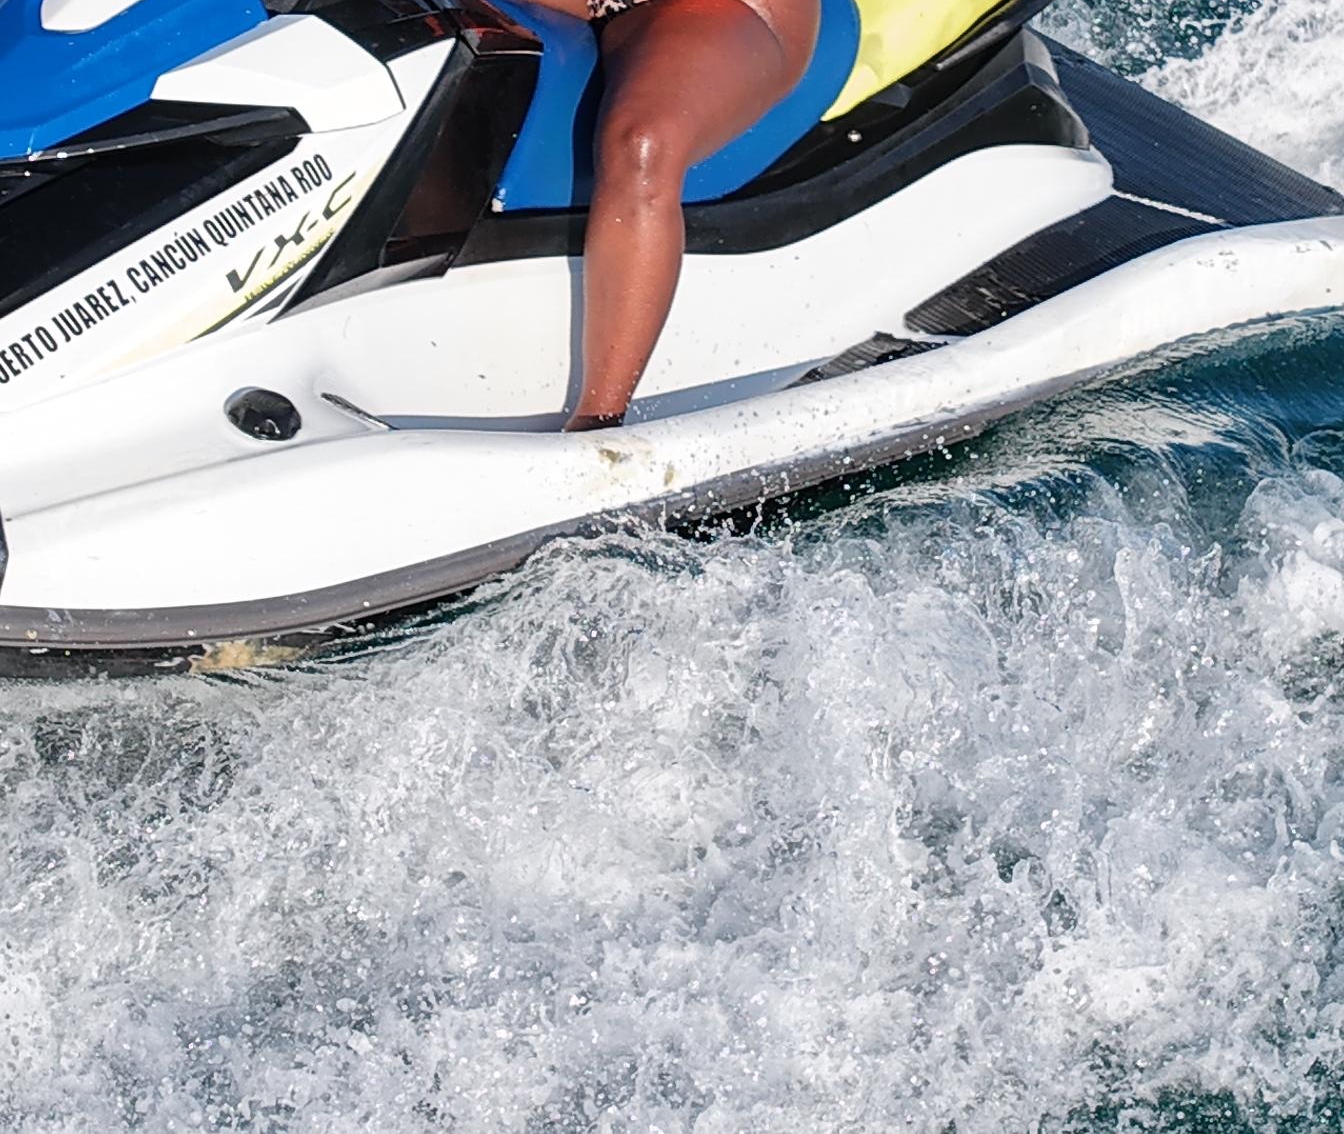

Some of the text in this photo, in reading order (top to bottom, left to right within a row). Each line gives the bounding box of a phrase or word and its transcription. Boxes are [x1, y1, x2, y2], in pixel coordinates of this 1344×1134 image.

[51, 279, 136, 343] JUAREZ,
[126, 232, 211, 293] CANCÚN
[203, 175, 299, 246] QUINTANA
[290, 154, 333, 194] ROO
